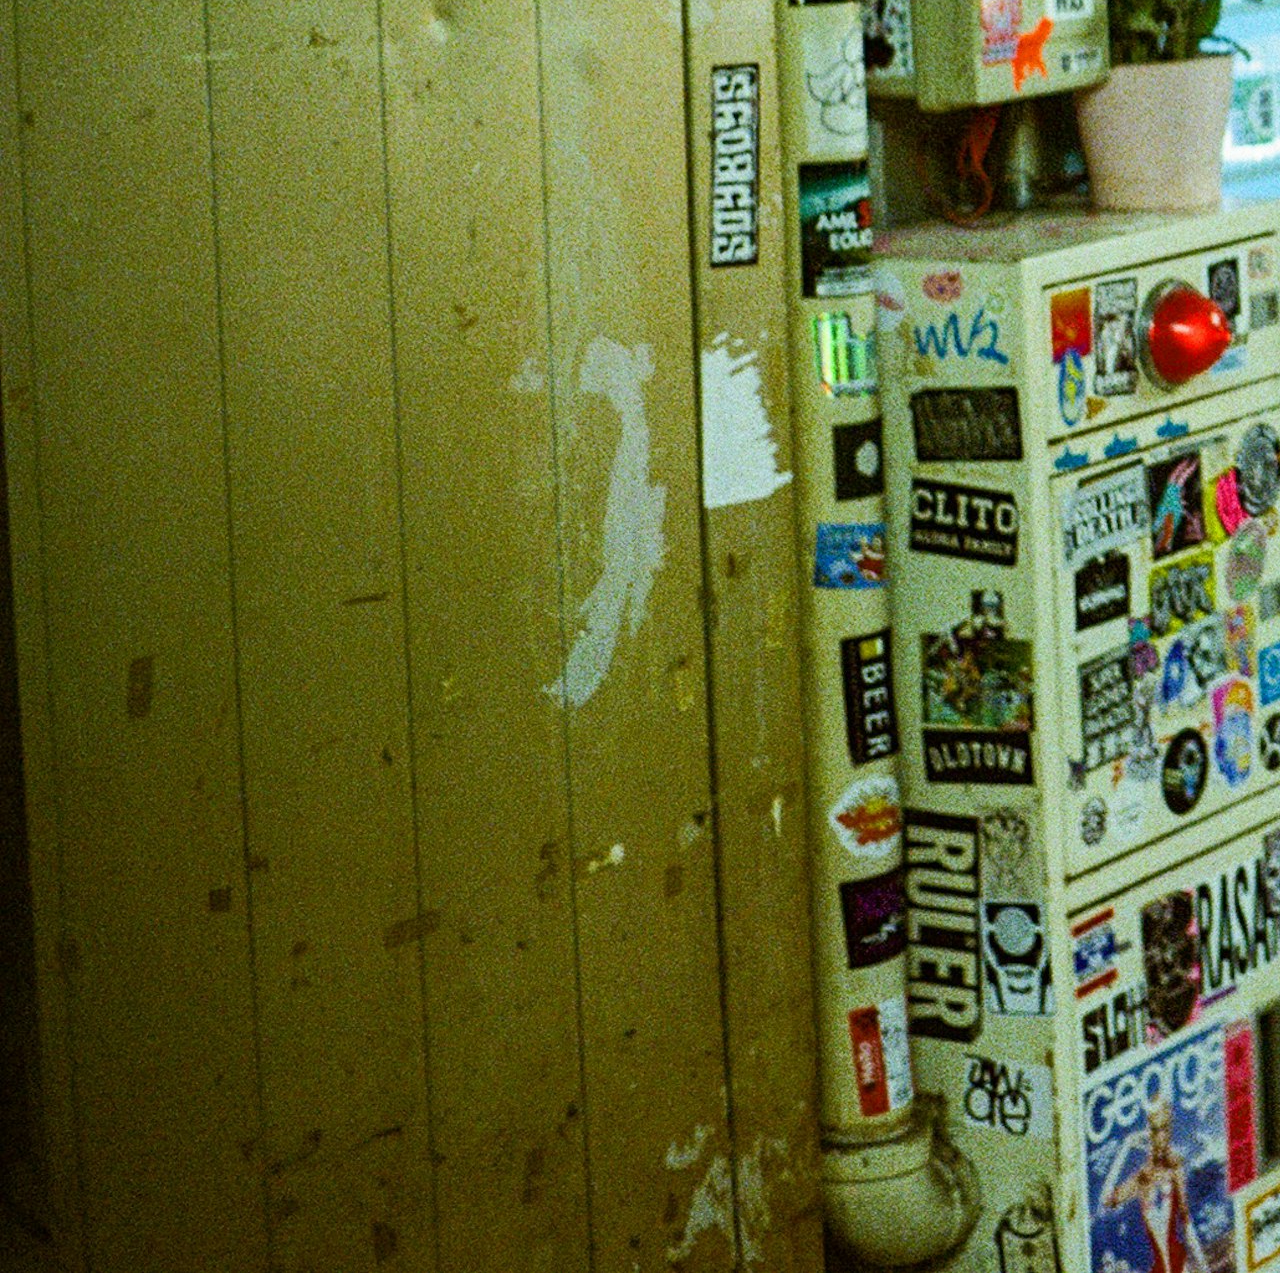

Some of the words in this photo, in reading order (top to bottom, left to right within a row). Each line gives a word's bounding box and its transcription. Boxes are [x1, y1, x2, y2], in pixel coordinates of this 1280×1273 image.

[911, 488, 1020, 534] CLITO
[861, 662, 892, 757] BEER
[904, 825, 981, 1030] RULER
